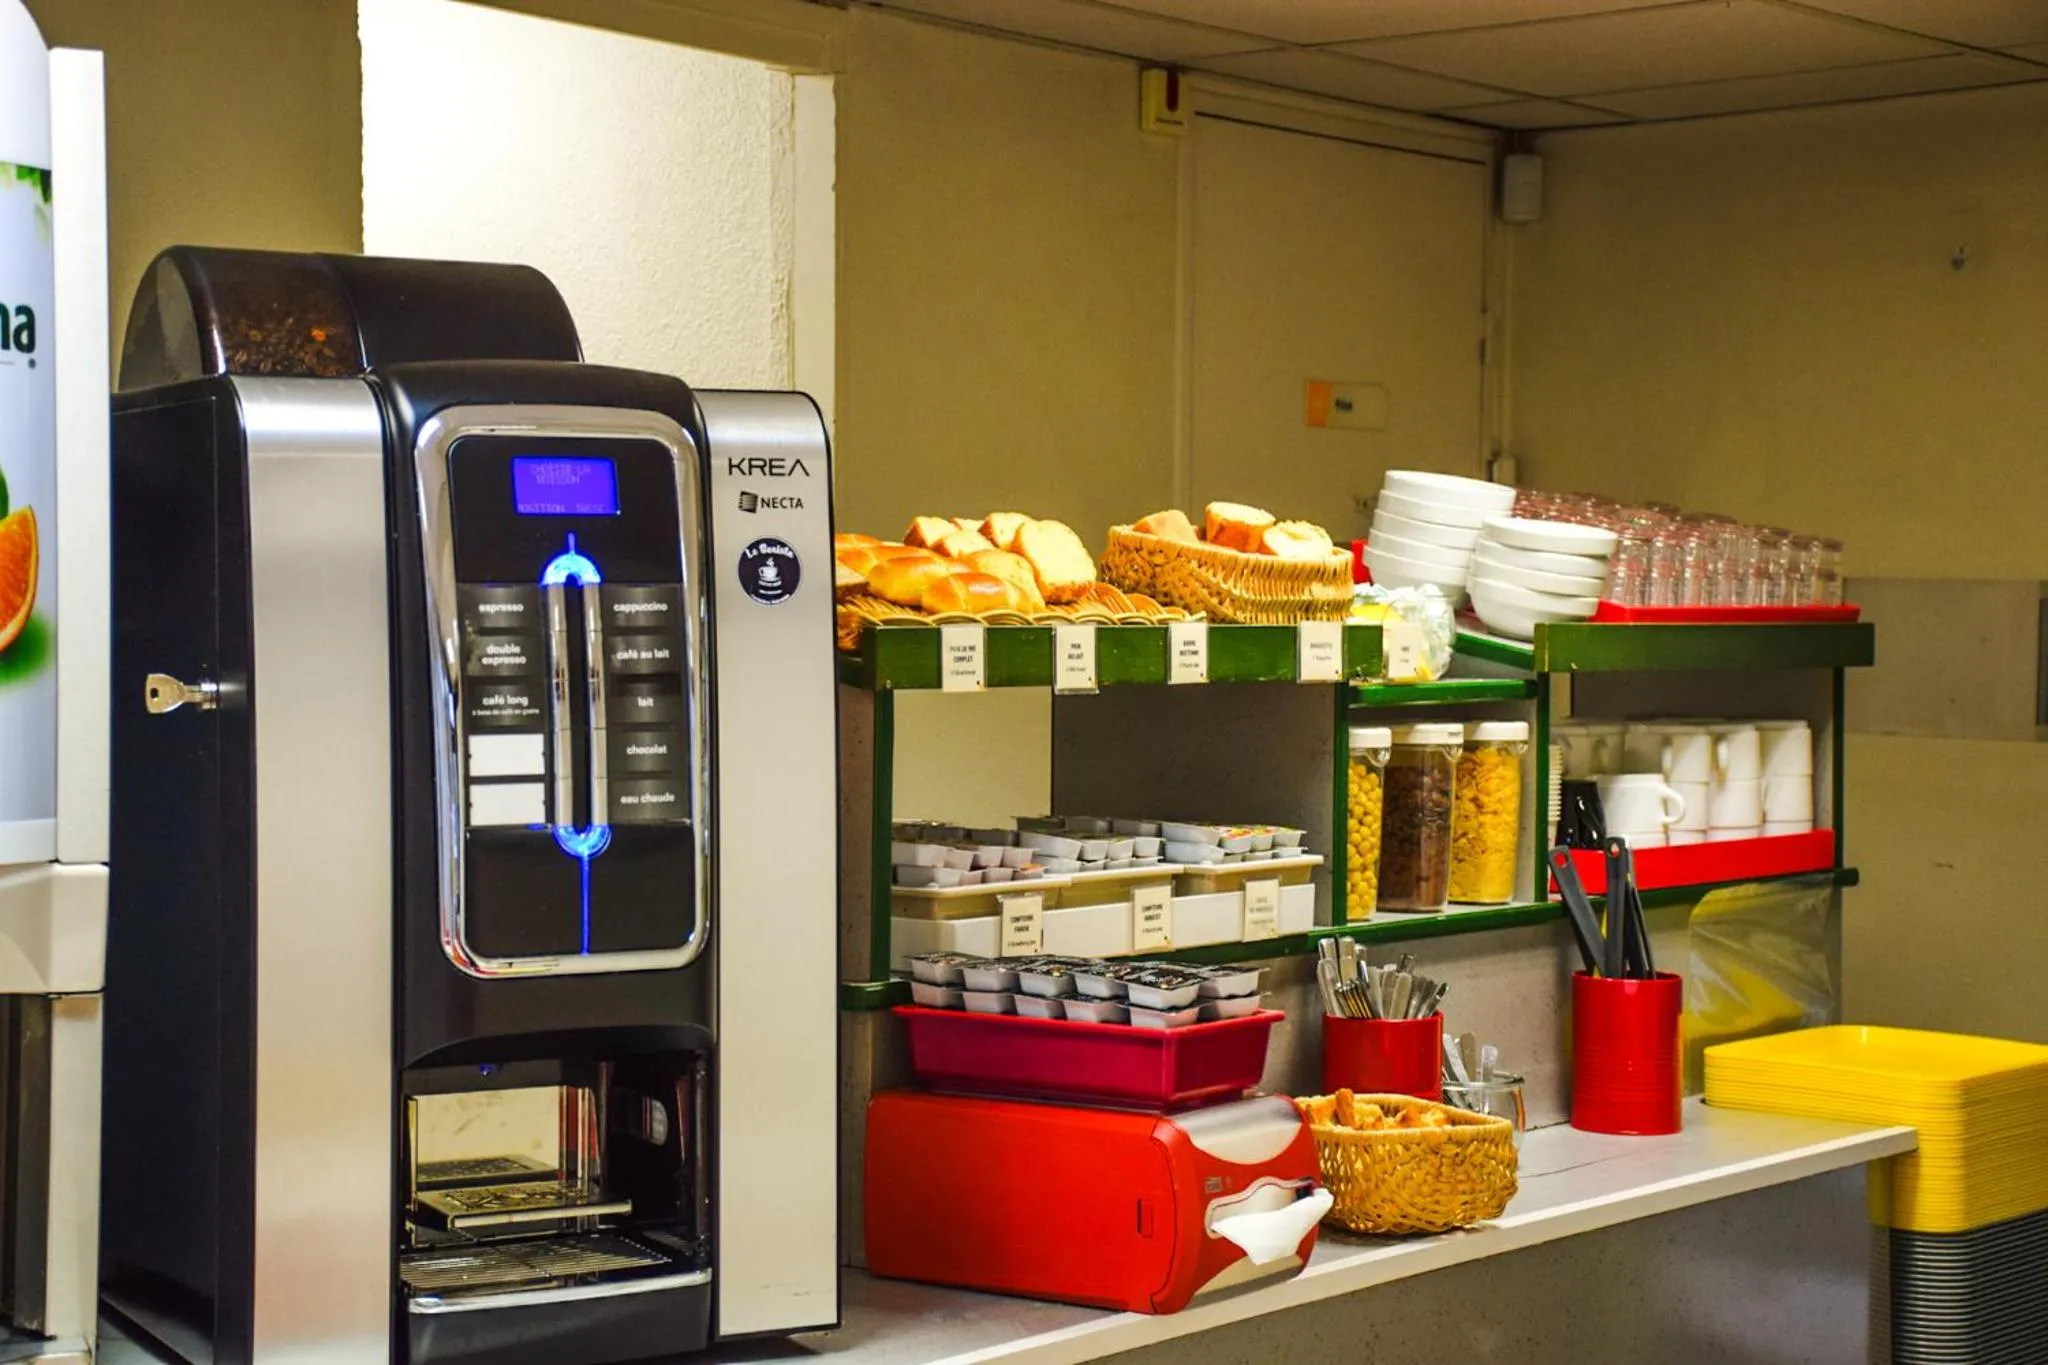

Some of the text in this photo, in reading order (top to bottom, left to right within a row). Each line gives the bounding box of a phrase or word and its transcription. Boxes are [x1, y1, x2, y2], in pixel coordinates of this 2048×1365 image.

[727, 457, 810, 477] KREA
[761, 496, 804, 510] NECTA
[613, 602, 668, 613] cappuccino
[486, 643, 521, 654] double
[616, 648, 670, 660] café au lait
[482, 694, 529, 707] café long
[637, 696, 654, 707] lait
[626, 743, 667, 755] chocolat
[620, 793, 676, 804] eau chaude
